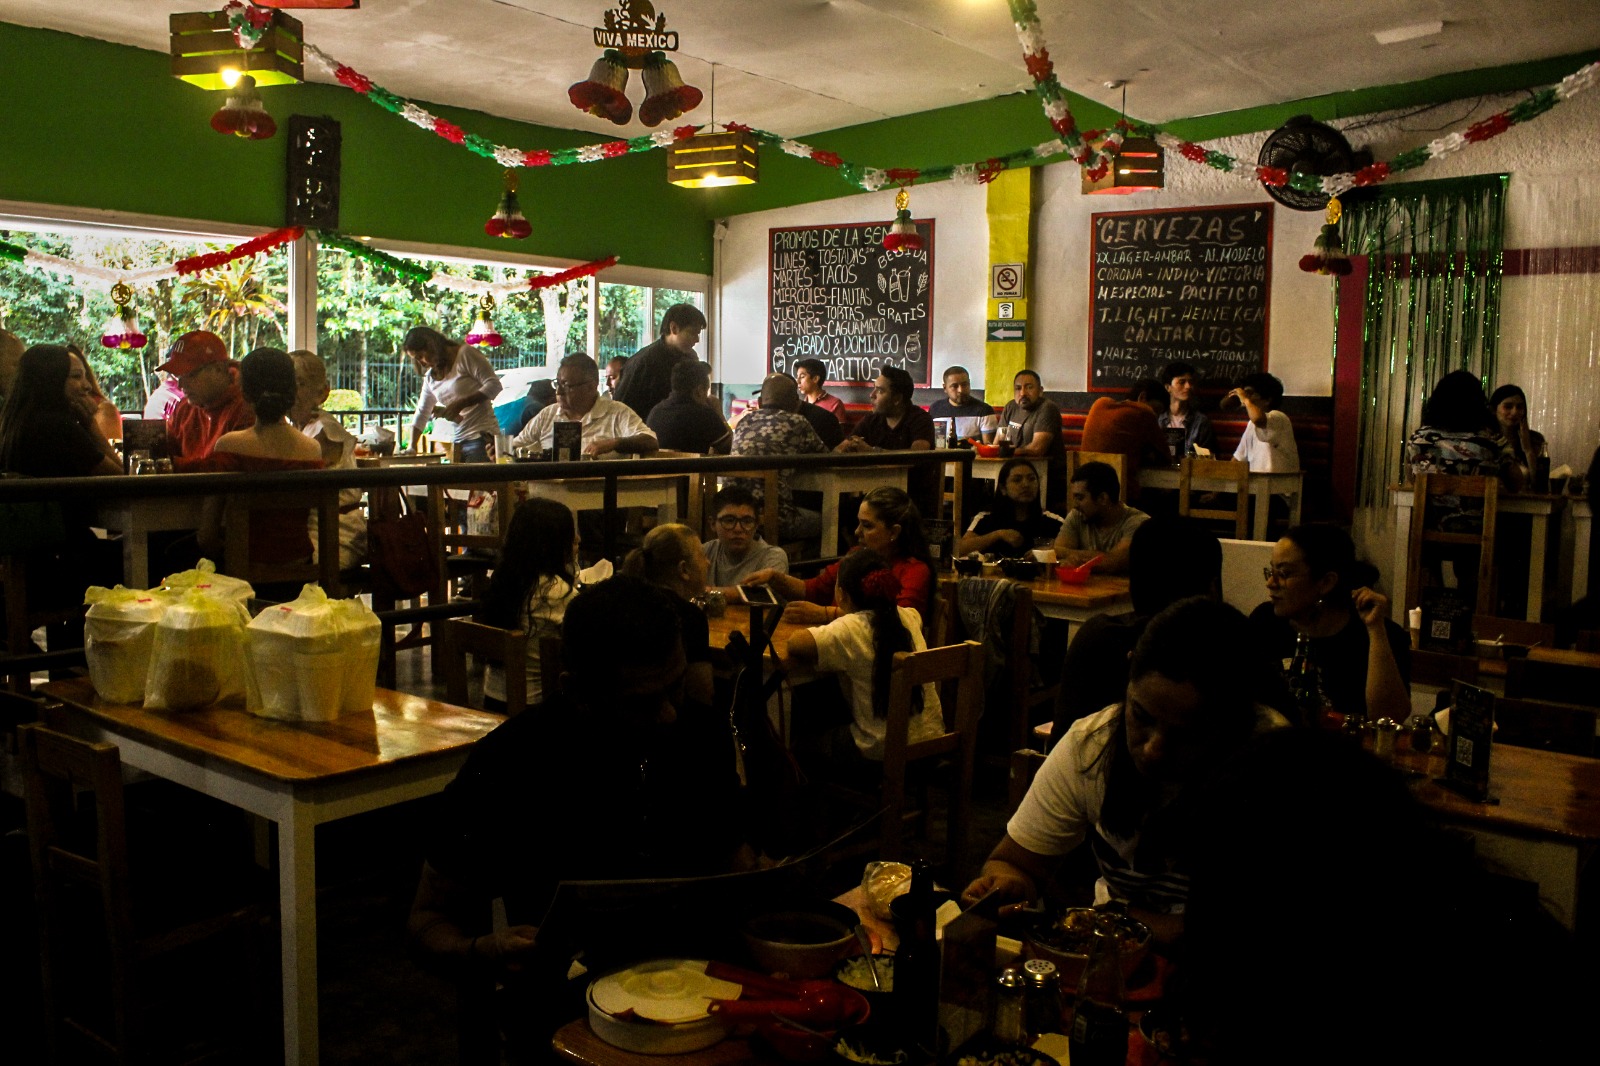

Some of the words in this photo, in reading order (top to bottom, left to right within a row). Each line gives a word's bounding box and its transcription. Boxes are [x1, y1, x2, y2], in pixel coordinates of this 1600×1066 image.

[596, 30, 623, 47] VIVA
[626, 32, 676, 49] MEXICO
[774, 231, 820, 251] PROMOS
[822, 229, 840, 248] DE
[844, 228, 859, 247] LA
[773, 251, 807, 271] LUNES
[817, 247, 867, 265] TOSTADAS
[773, 267, 813, 288] MARTES
[820, 264, 858, 285] TACOS
[1097, 267, 1143, 281] CORONA
[1179, 284, 1258, 302] PACIFICO
[772, 305, 814, 321] JUEVES
[825, 305, 864, 321] TORTAS
[877, 302, 926, 325] GRATIS
[1180, 305, 1265, 323] HEINEKEN
[786, 335, 831, 357] SABADO
[832, 337, 843, 356] &
[843, 333, 899, 356] DOMINGO
[1123, 325, 1246, 347] CANTARITOS
